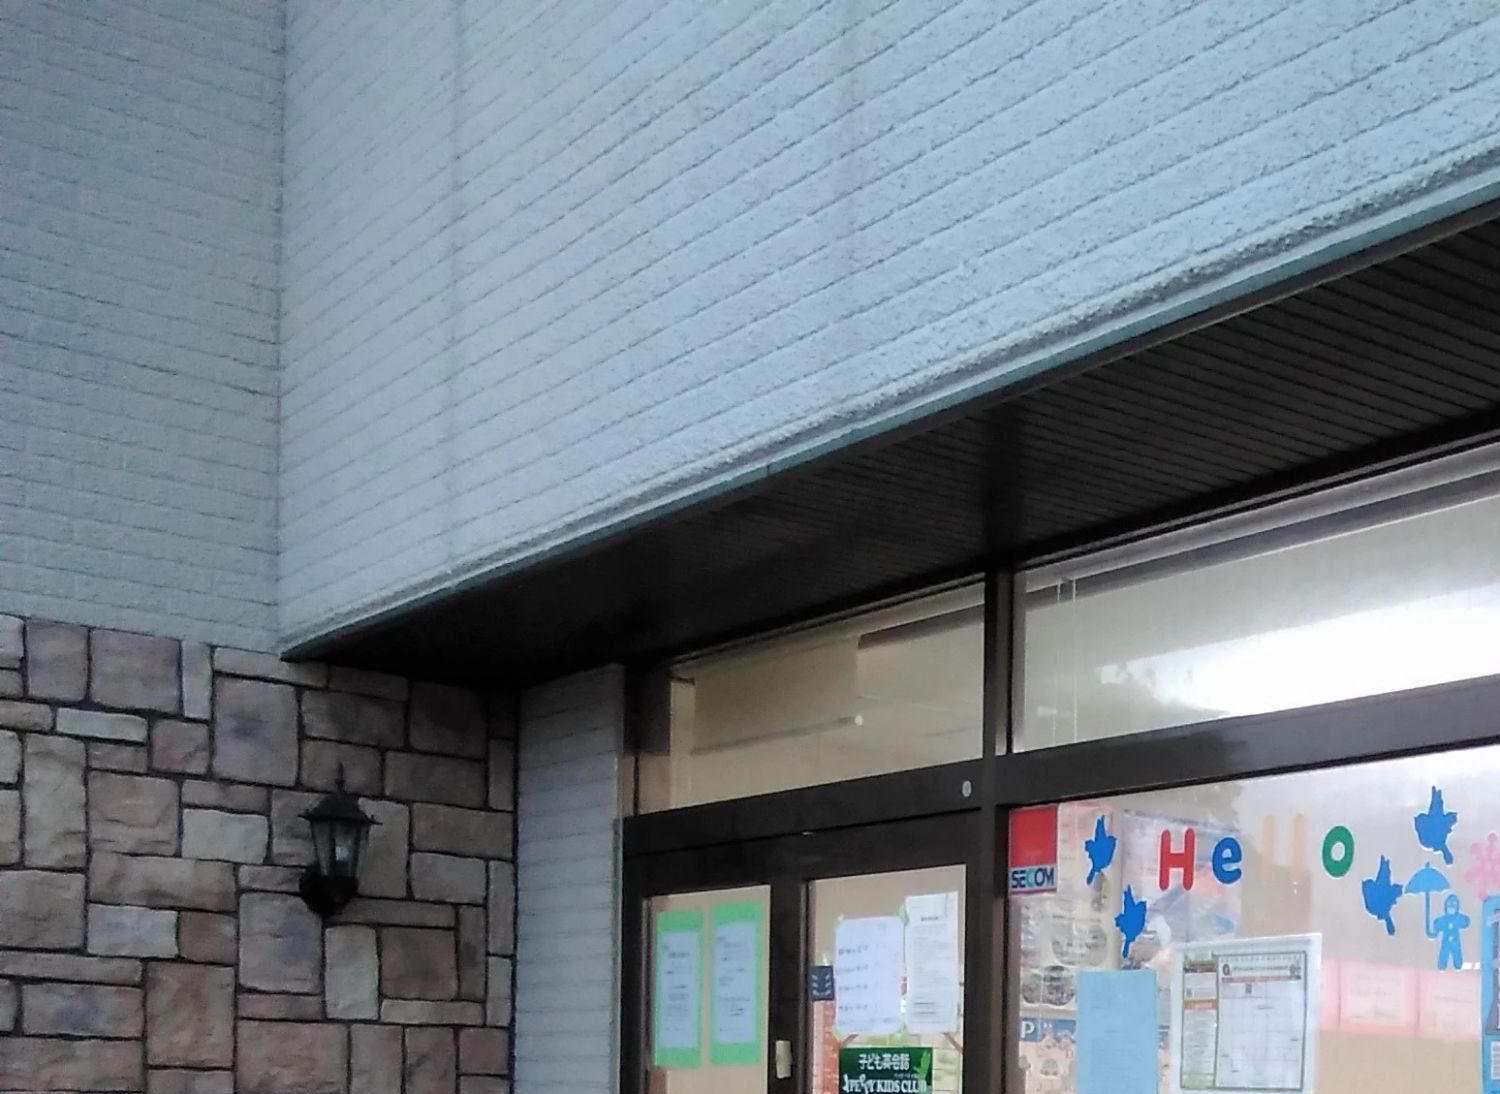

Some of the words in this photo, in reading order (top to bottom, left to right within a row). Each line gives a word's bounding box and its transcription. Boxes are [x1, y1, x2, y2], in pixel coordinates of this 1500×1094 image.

[1012, 867, 1055, 888] SECOM
[858, 1053, 910, 1070] 子ども英会話
[876, 1079, 900, 1093] KIDS
